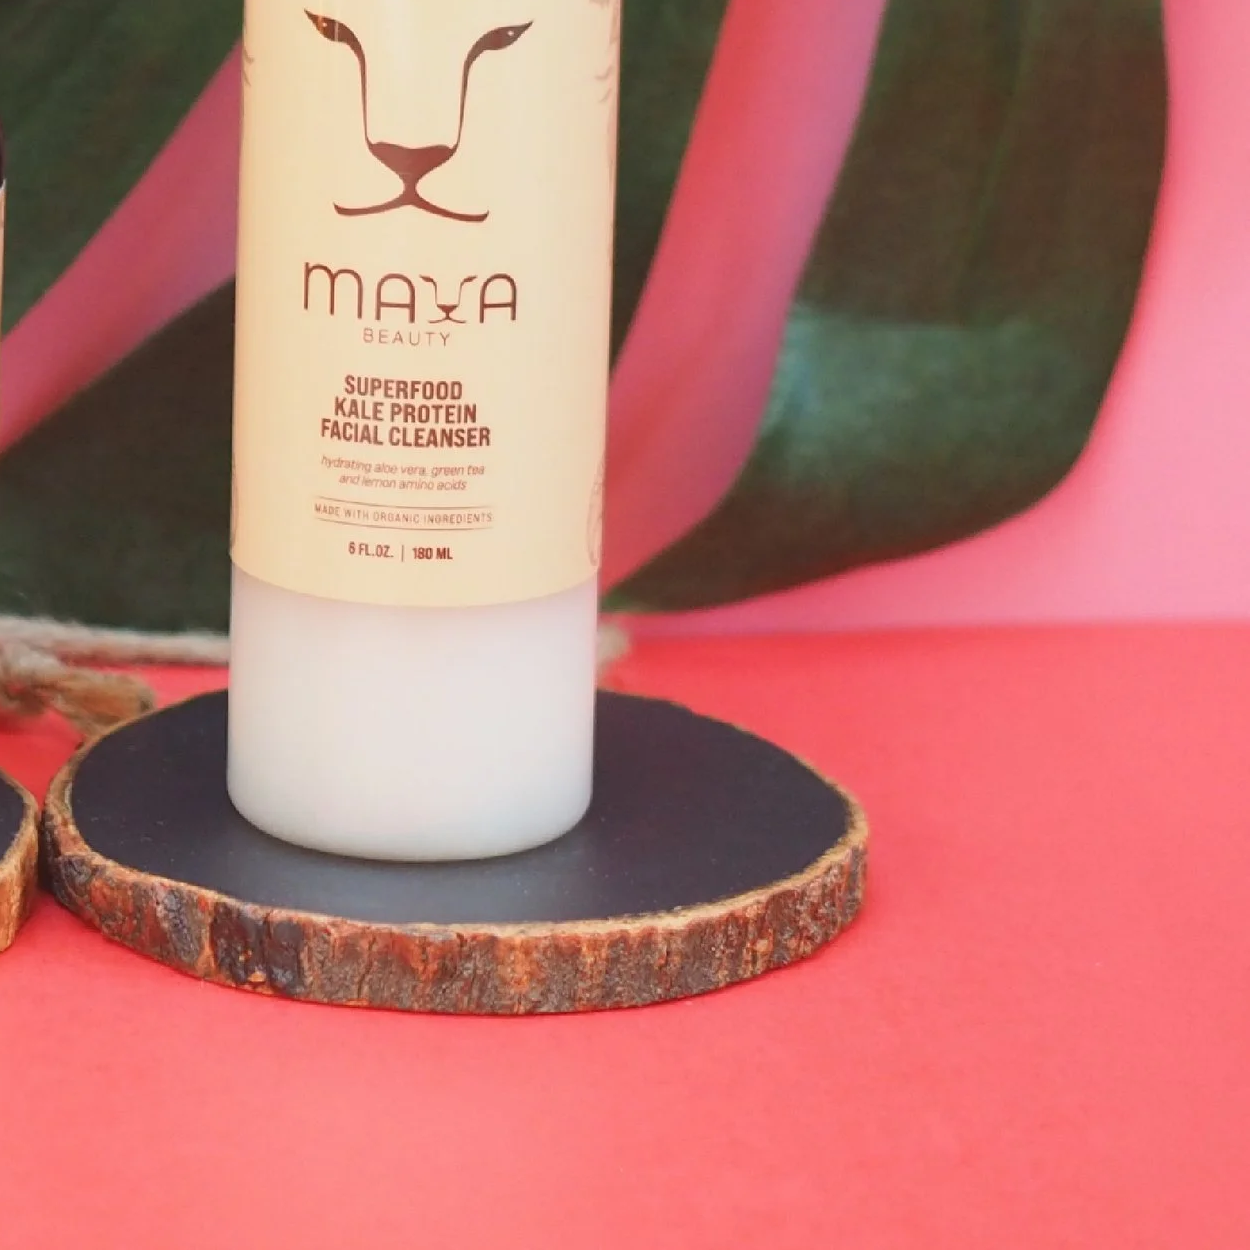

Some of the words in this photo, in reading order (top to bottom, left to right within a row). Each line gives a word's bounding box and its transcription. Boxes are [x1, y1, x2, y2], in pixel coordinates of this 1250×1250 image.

[363, 328, 451, 347] BEAUTY
[344, 374, 463, 400] SUPERFOOD
[334, 396, 385, 422] KALE
[390, 402, 477, 424] PROTEIN
[320, 418, 384, 446] FACIAL
[388, 426, 491, 448] CLEANSER
[321, 454, 372, 473] hydrating
[374, 463, 398, 475] aloe
[431, 467, 465, 479] green
[467, 465, 485, 475] tea
[338, 473, 360, 485] and
[362, 475, 397, 488] lemon
[398, 478, 434, 490] amino
[436, 478, 467, 491] acids
[314, 503, 340, 517] MADE
[344, 508, 369, 520] WITH
[373, 511, 420, 524] ORGANIC
[424, 512, 493, 524] INGREDIENTS
[348, 541, 356, 554] 6
[412, 547, 433, 560] 180
[436, 547, 453, 560] ML
